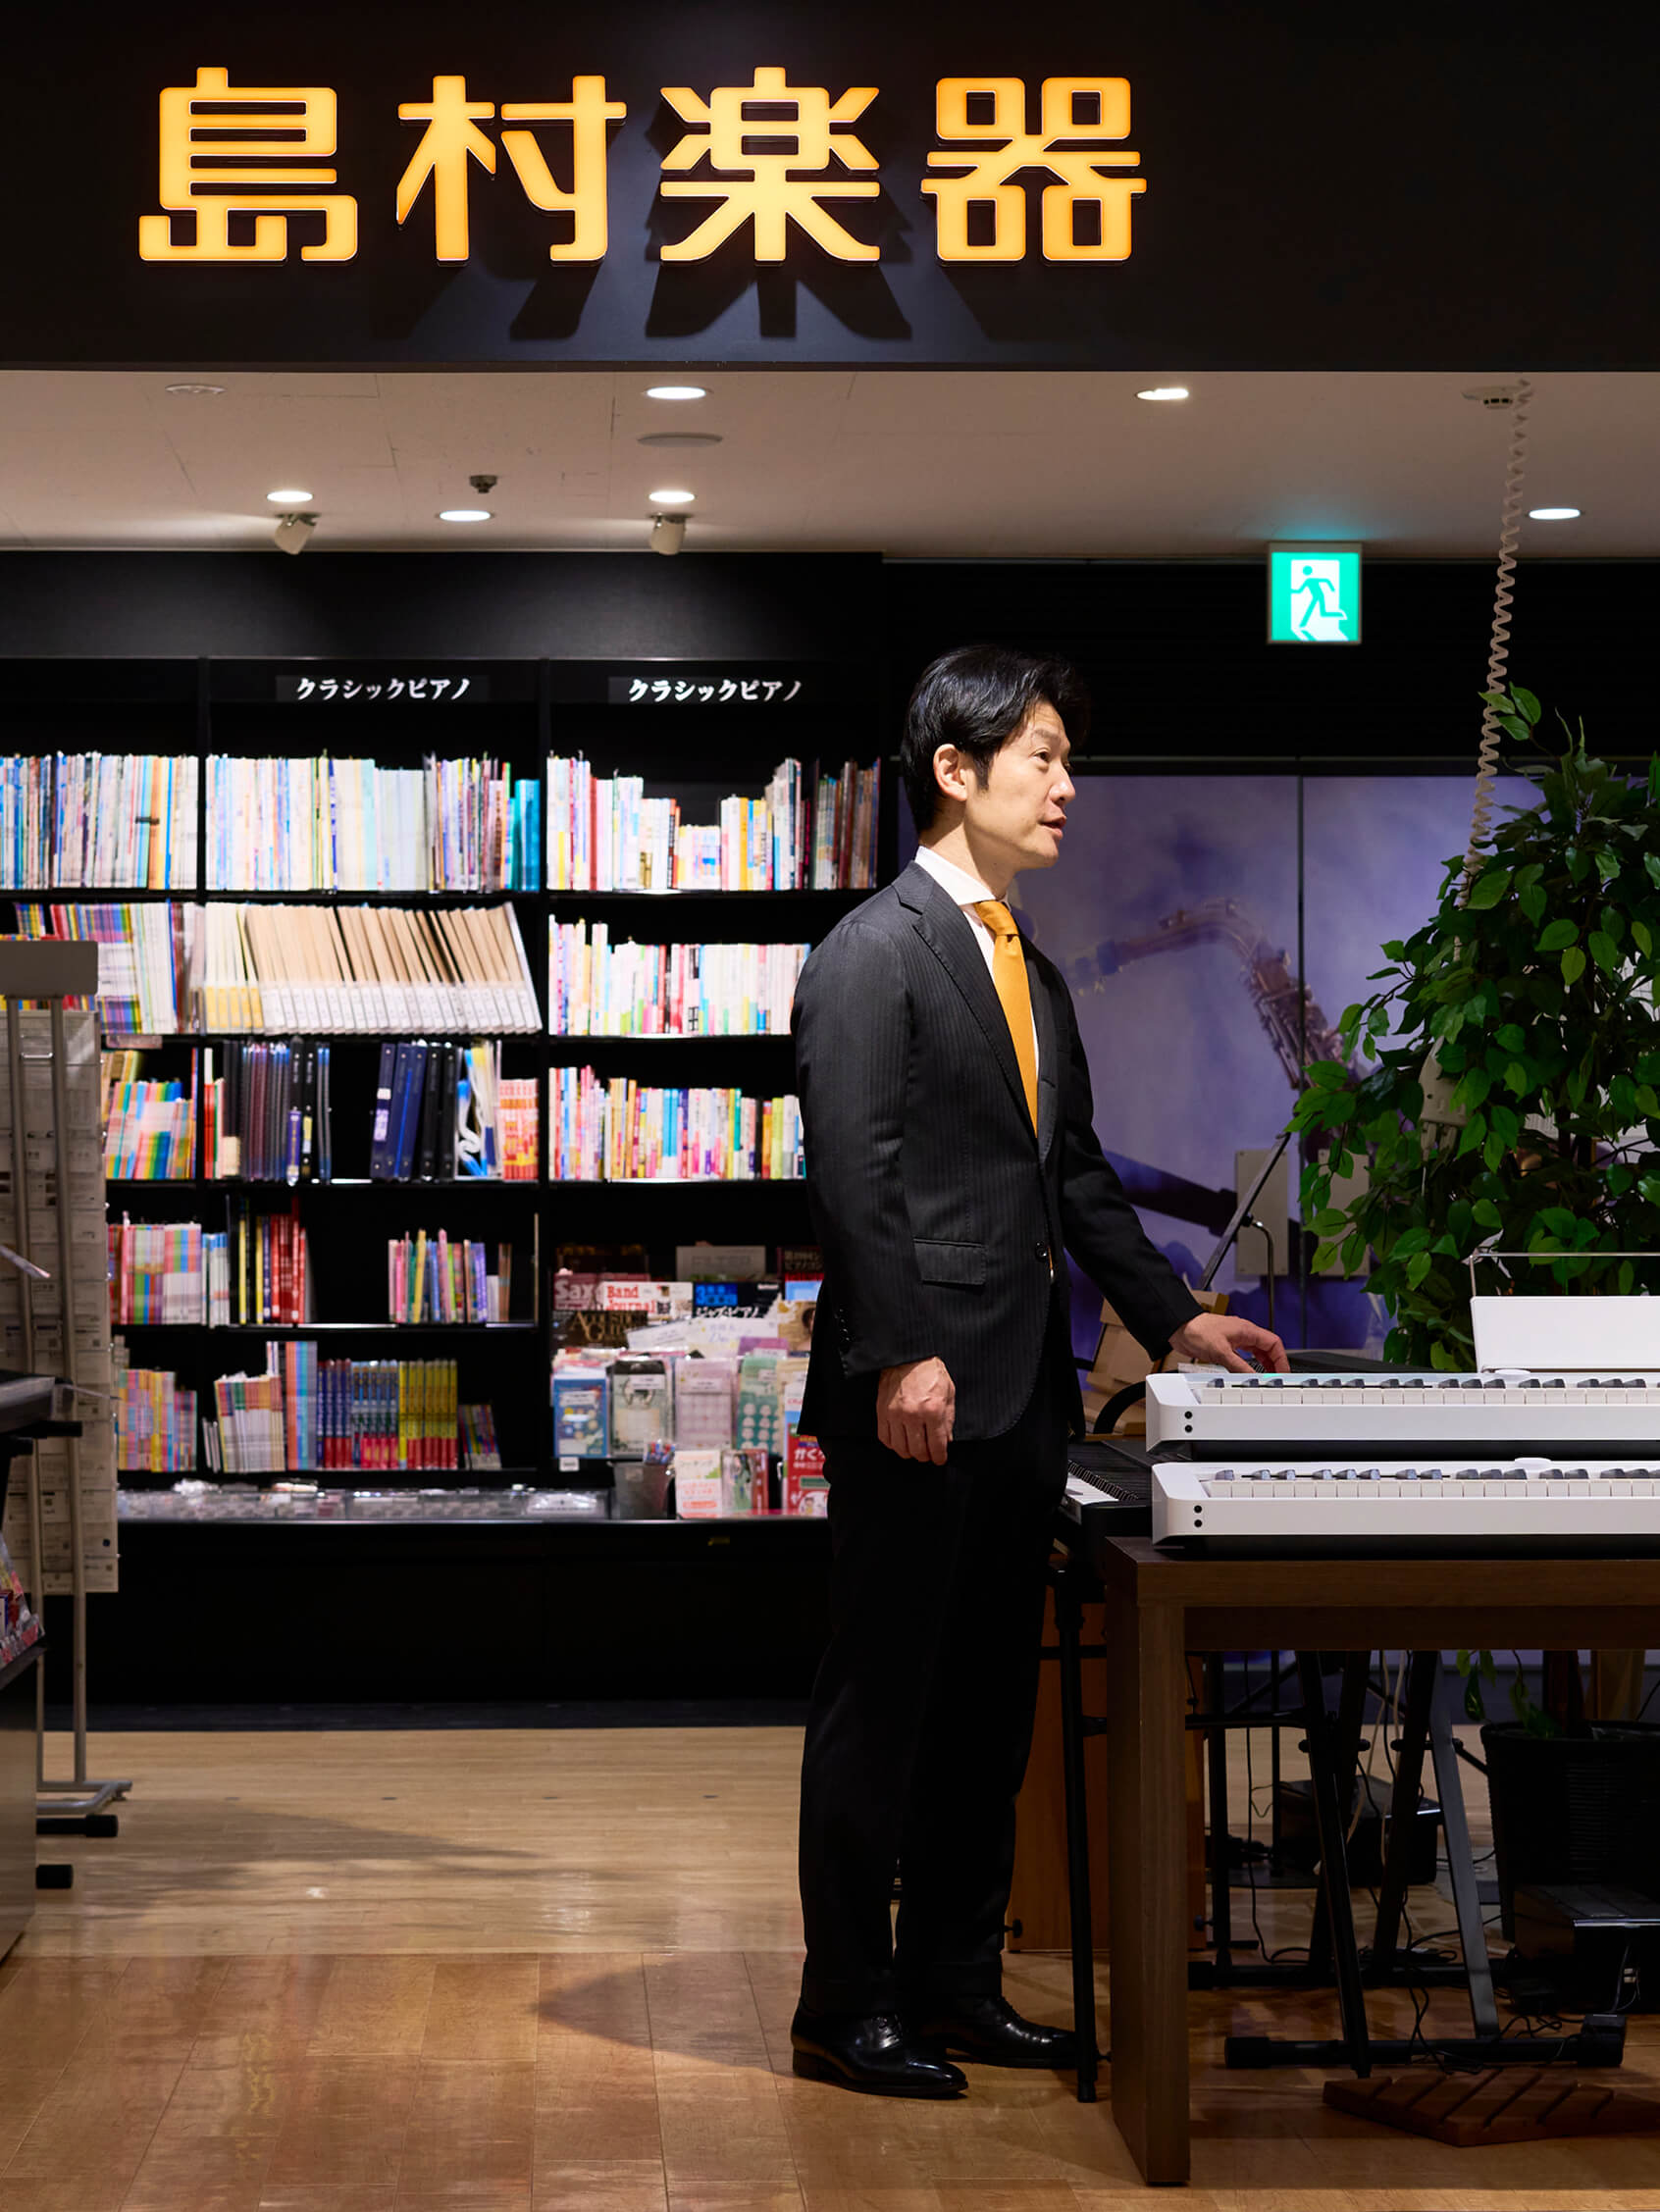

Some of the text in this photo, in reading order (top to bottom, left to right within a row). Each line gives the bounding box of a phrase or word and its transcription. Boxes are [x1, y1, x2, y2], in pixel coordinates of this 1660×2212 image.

[138, 66, 1147, 264] 島村楽器
[296, 677, 470, 701] クラシックピアノ
[628, 678, 803, 701] クラシックピアノ
[606, 1284, 640, 1299] Band
[605, 1300, 656, 1313] Journal
